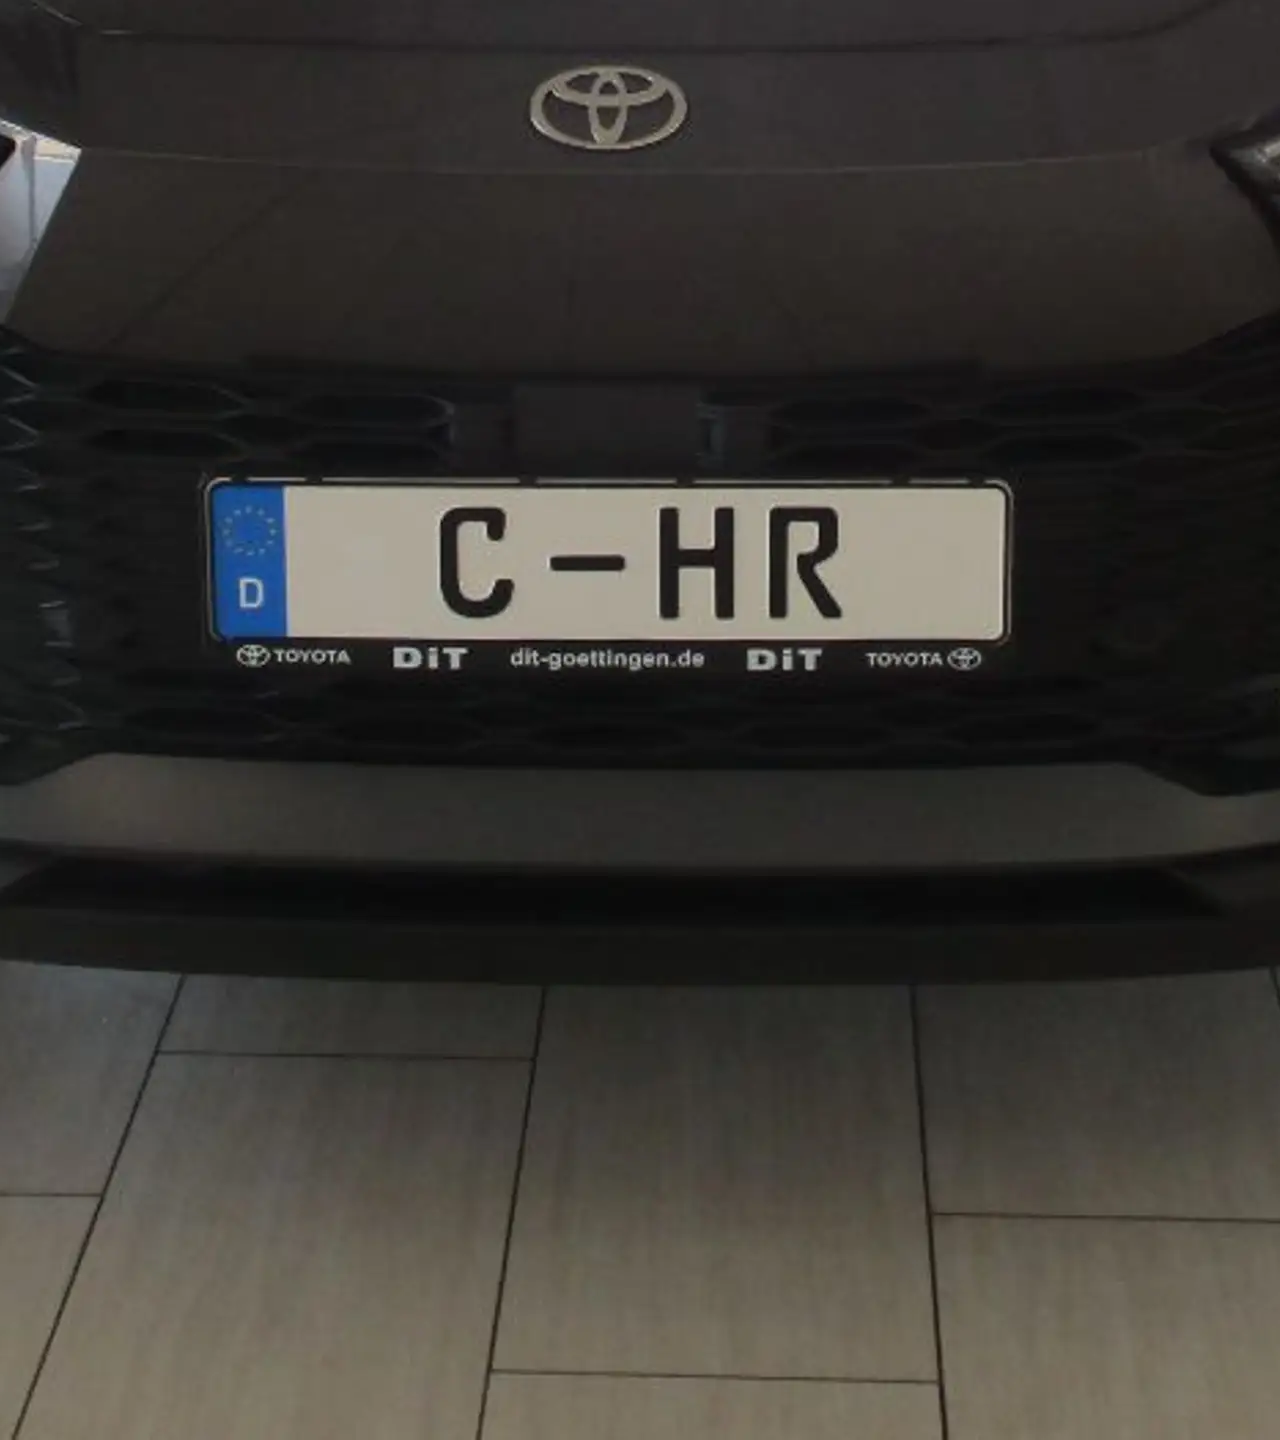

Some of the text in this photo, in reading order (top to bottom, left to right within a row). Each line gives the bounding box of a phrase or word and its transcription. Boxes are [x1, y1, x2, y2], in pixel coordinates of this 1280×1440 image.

[238, 577, 265, 610] D
[273, 648, 352, 666] TOYOTA
[509, 647, 705, 671] dit-goettingen.de
[865, 651, 944, 668] TOYOTA
